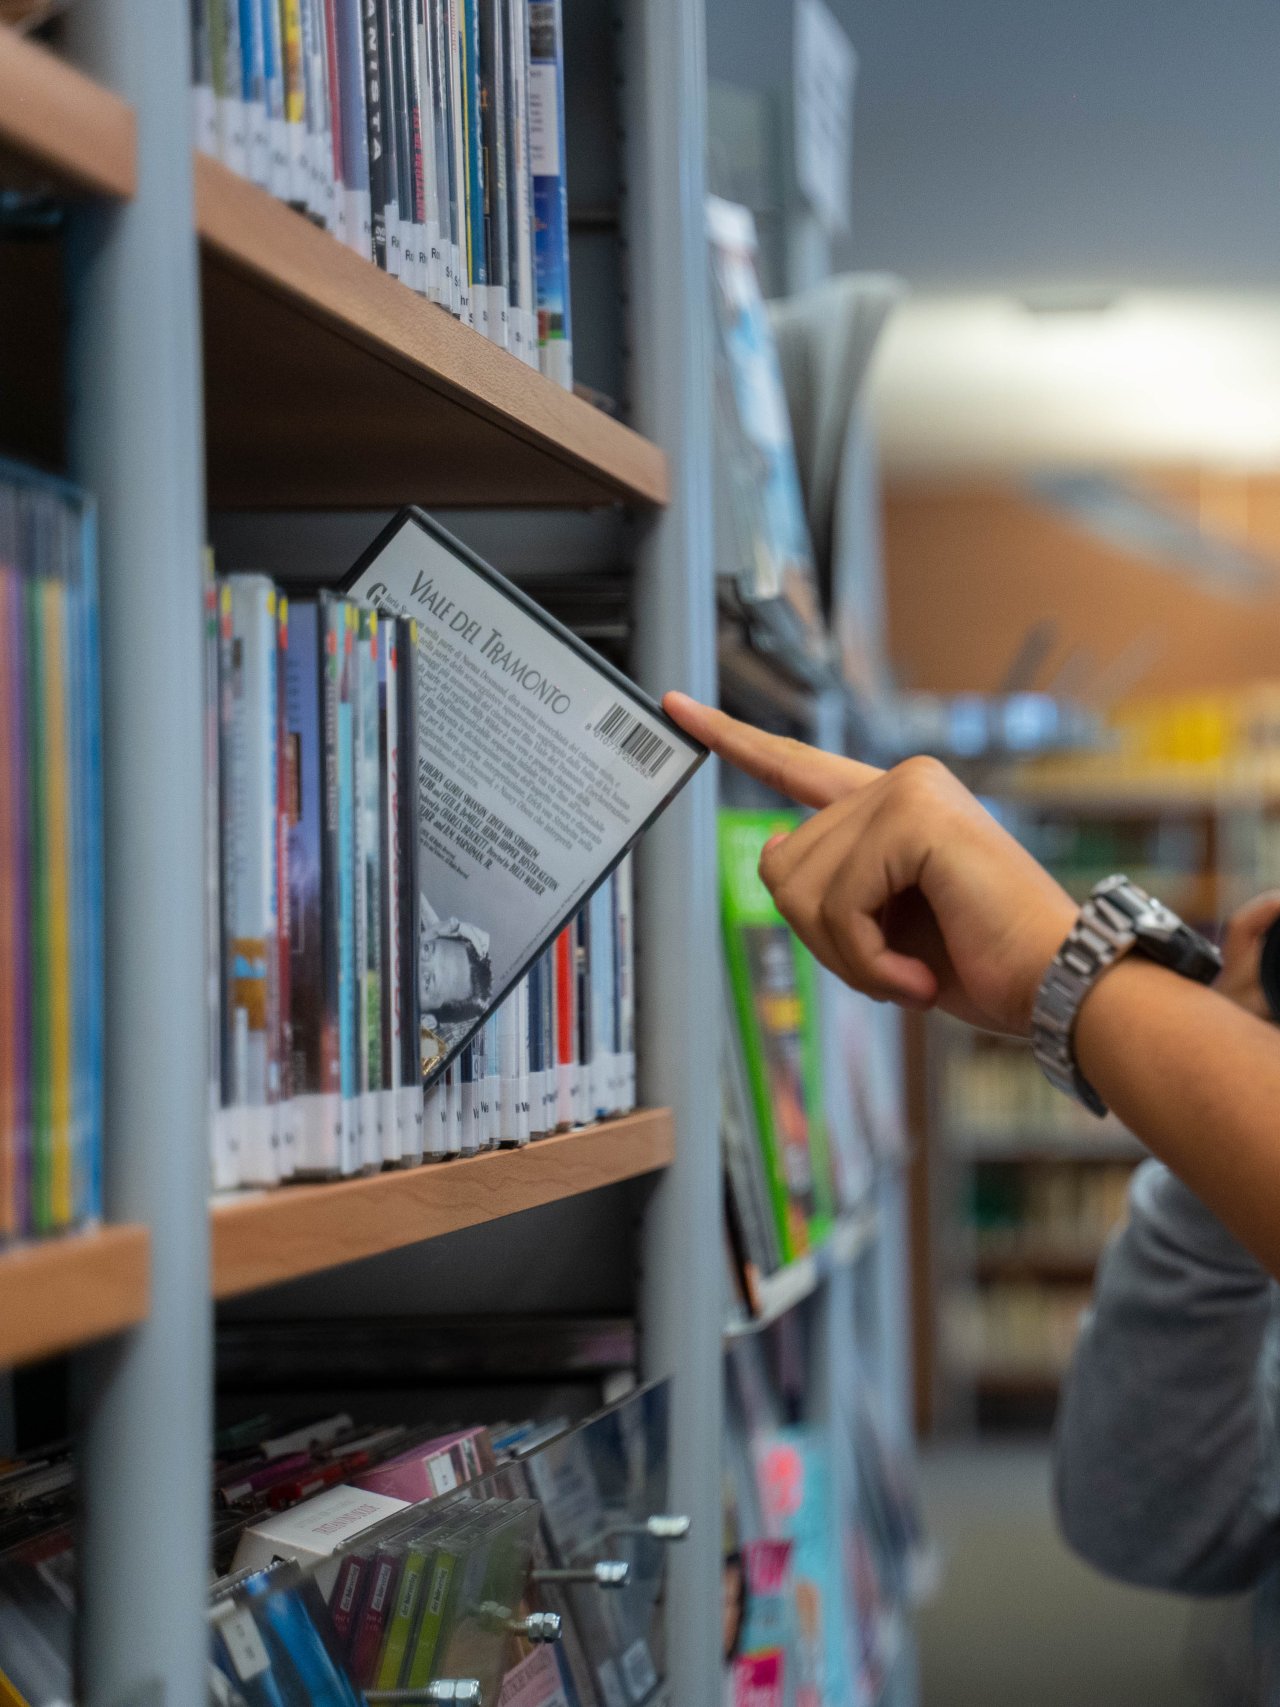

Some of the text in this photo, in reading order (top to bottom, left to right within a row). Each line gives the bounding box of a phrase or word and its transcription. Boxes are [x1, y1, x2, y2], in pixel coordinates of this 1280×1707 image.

[410, 570, 455, 620] VIALE
[449, 610, 483, 645] DEL
[480, 628, 569, 714] TRAMONTO
